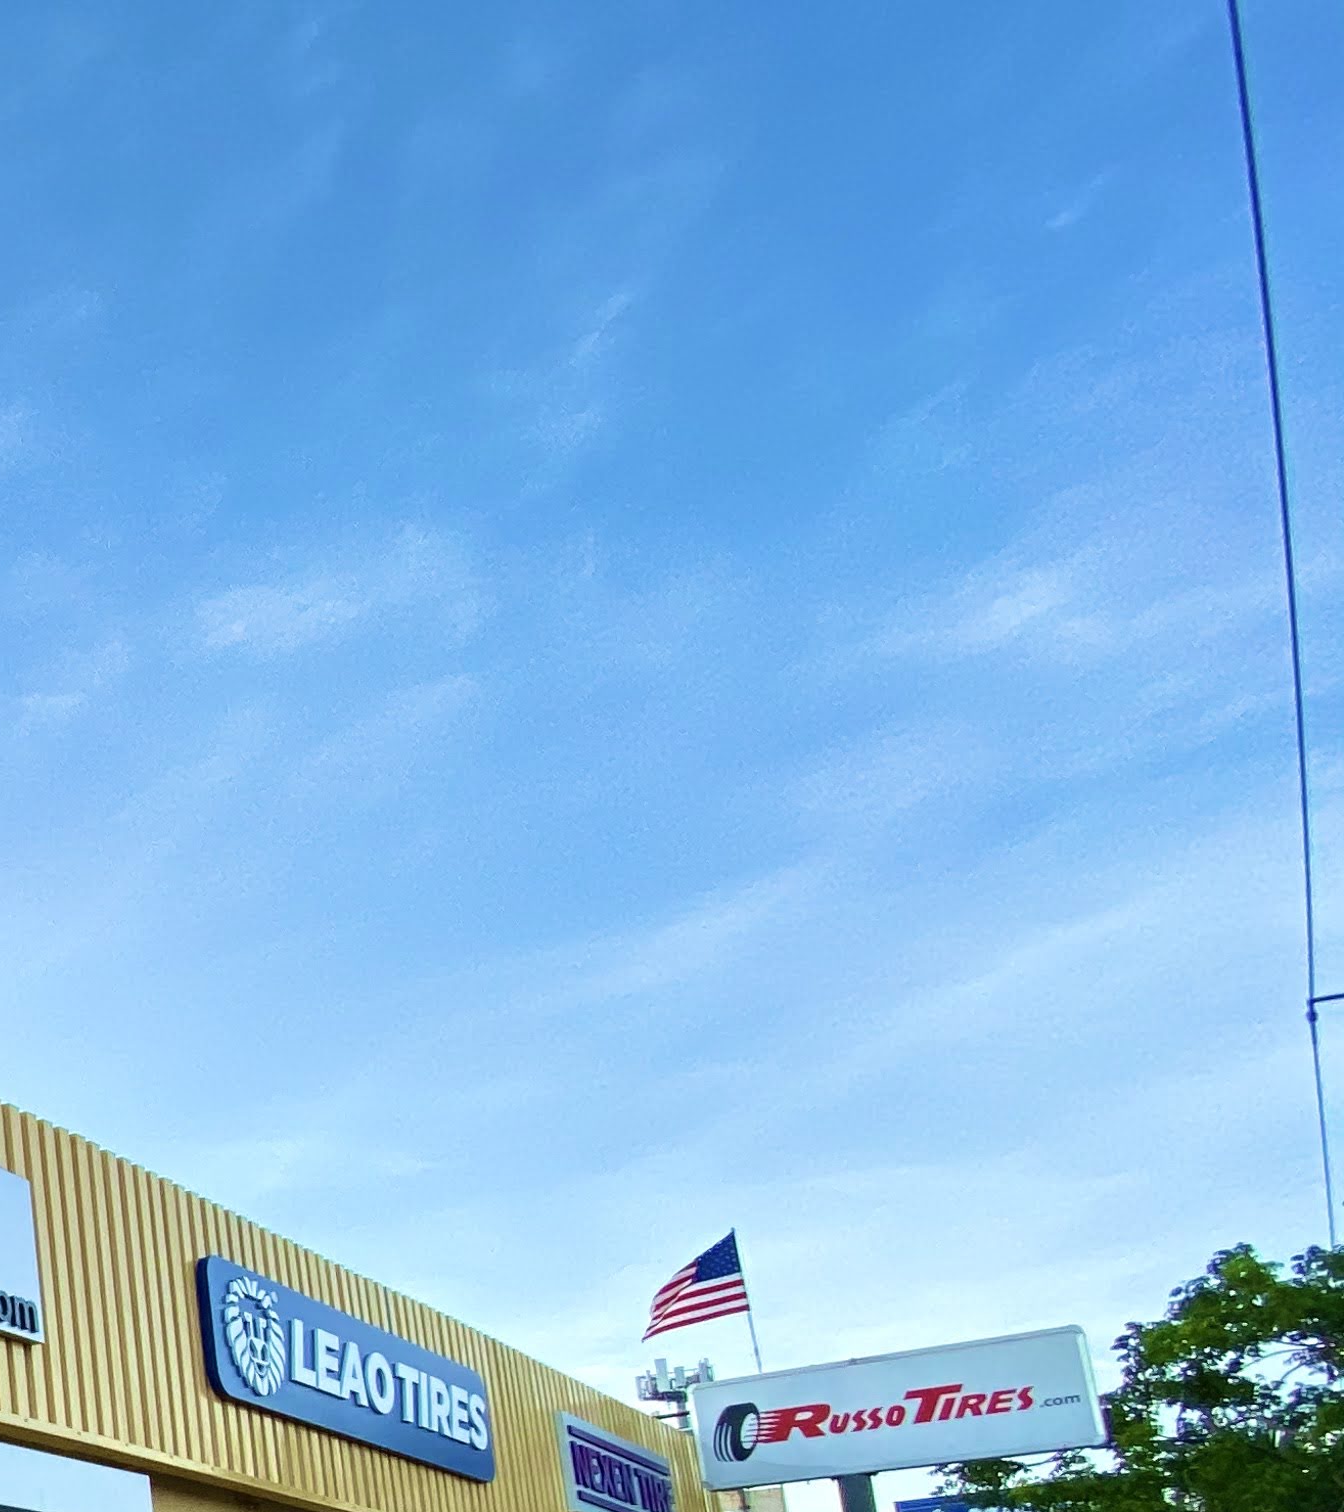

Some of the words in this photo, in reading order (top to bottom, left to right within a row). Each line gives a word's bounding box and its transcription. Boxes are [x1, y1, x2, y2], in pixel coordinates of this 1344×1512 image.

[289, 1318, 395, 1415] LEAO
[393, 1361, 488, 1451] TIRES
[1040, 1393, 1081, 1409] .com
[569, 1440, 638, 1506] NEXEN
